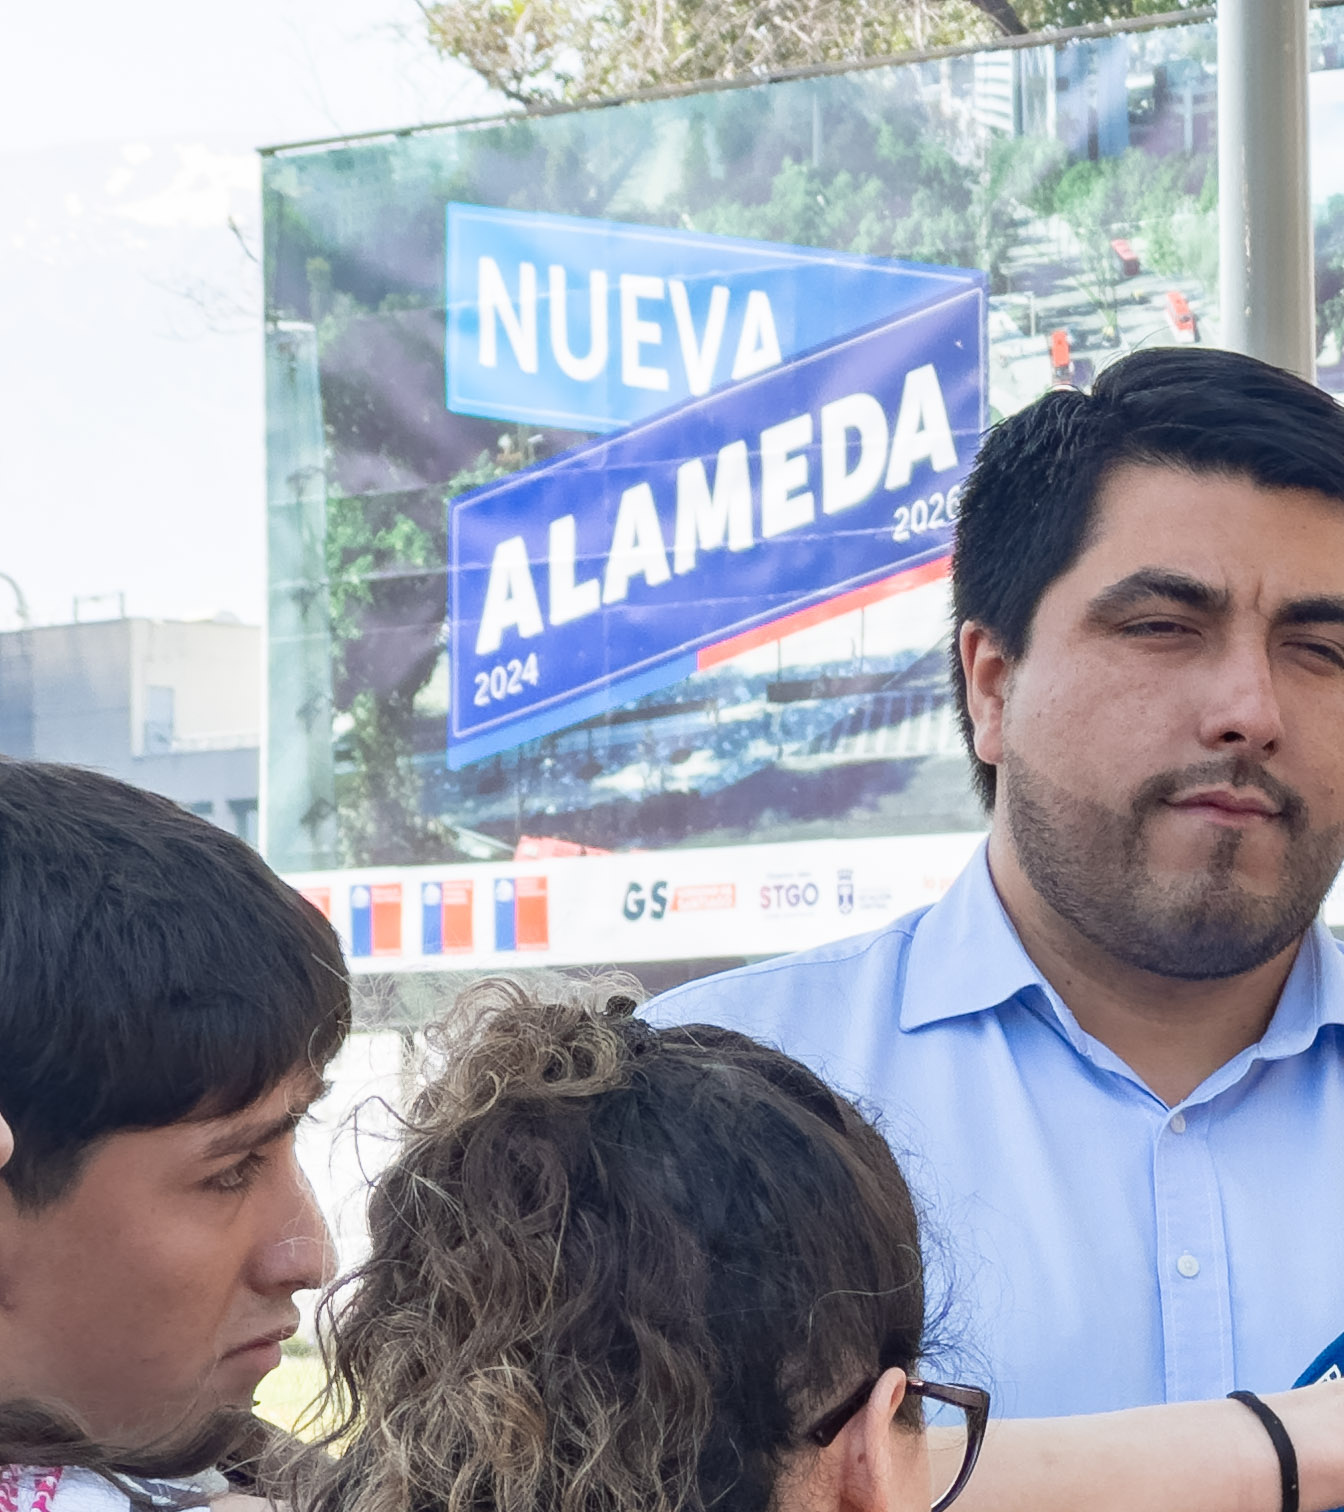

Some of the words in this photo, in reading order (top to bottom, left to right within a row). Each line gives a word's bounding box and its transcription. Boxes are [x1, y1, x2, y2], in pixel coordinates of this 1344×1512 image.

[477, 256, 782, 397] NUEVA
[475, 363, 959, 656] ALAMEDA
[892, 484, 963, 542] 2026
[473, 652, 539, 706] 2024
[623, 881, 668, 921] GS
[760, 882, 819, 910] STGO
